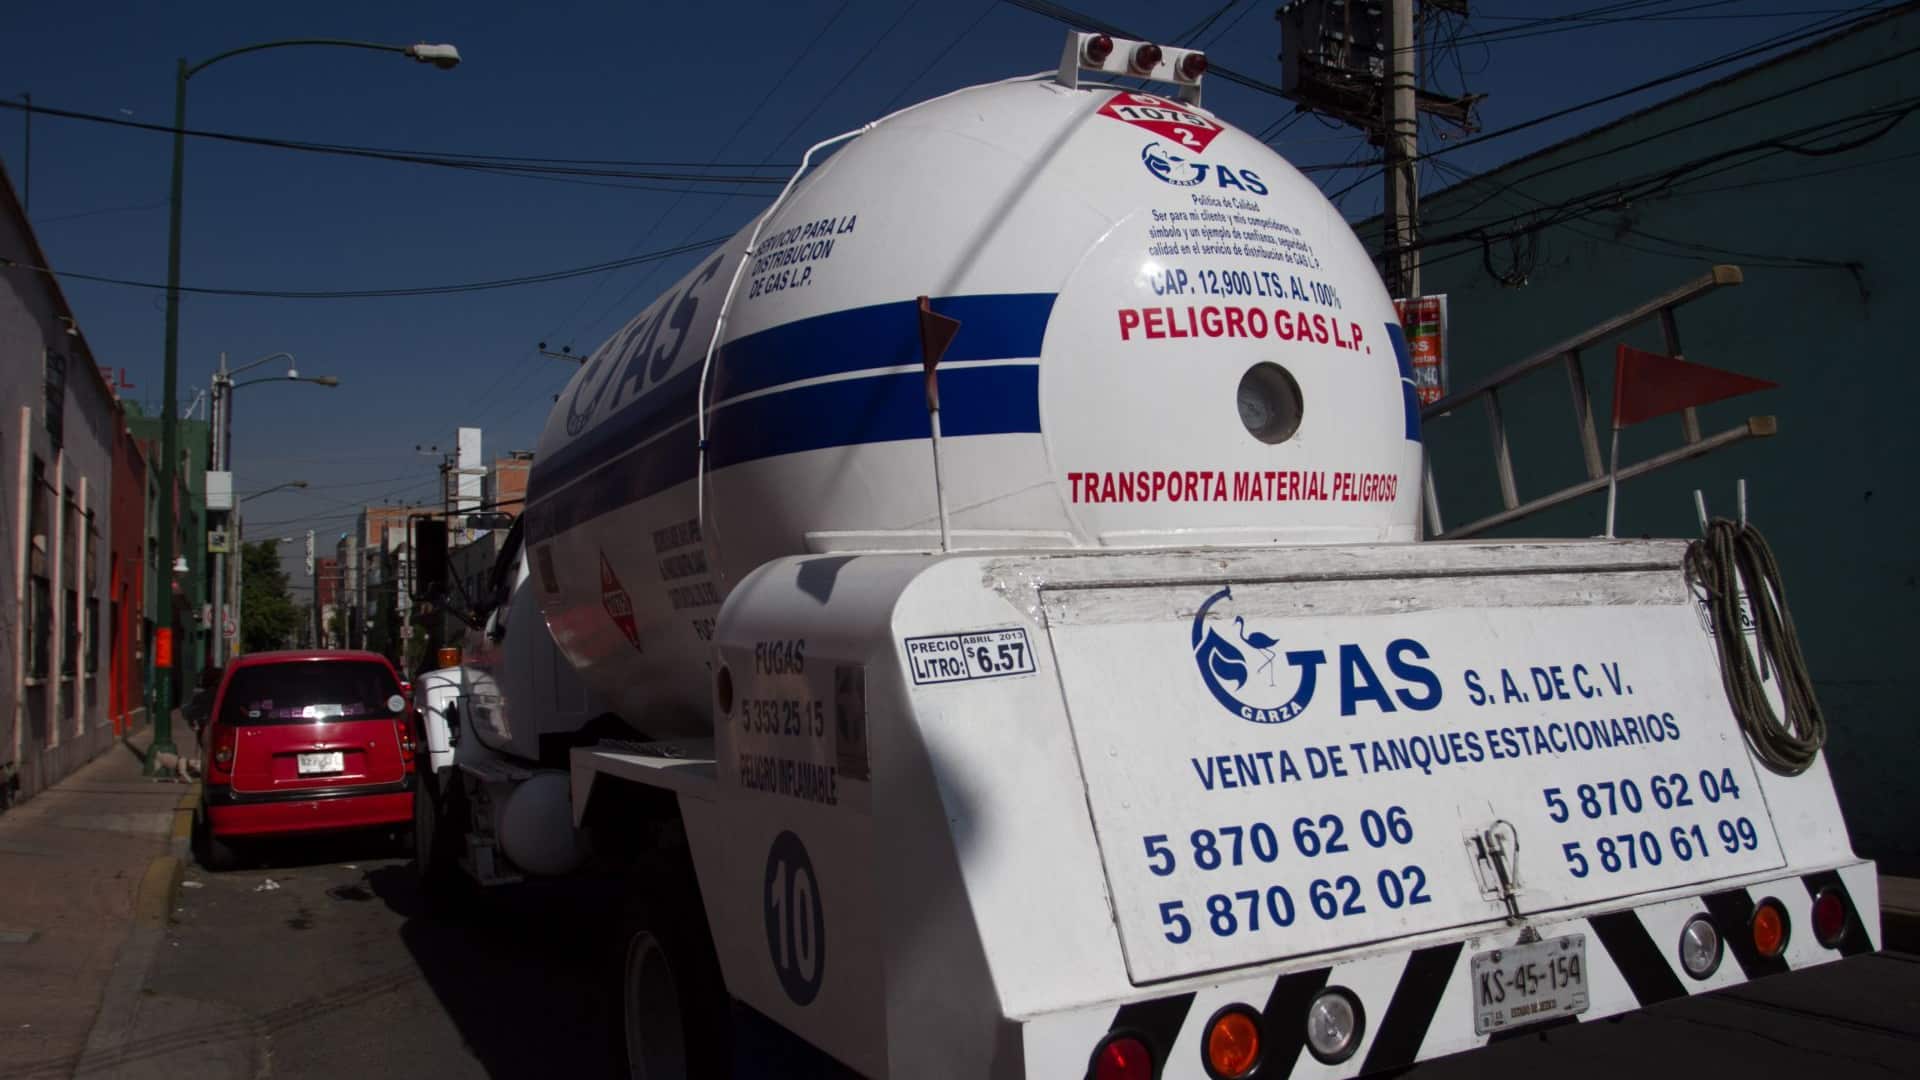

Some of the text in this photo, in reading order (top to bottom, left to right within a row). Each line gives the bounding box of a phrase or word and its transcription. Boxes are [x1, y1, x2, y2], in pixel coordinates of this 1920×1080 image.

[1119, 105, 1206, 127] 1075
[1172, 127, 1203, 146] 2
[1152, 209, 1167, 222] Ser
[1170, 212, 1188, 225] para
[1189, 210, 1199, 221] mi
[1200, 210, 1227, 222] cliente
[1233, 213, 1246, 225] mis
[1223, 197, 1232, 208] de
[801, 217, 837, 241] PARA
[837, 214, 857, 234] LA
[1189, 228, 1200, 237] un
[1201, 226, 1231, 241] ejemplo
[1232, 228, 1242, 239] de
[751, 238, 835, 277] DISTRIBUCION
[1149, 242, 1179, 256] calidad
[1181, 245, 1191, 255] en
[1192, 243, 1200, 255] el
[1201, 243, 1232, 256] servicio
[1233, 245, 1243, 256] de
[1293, 252, 1309, 268] GAS
[748, 277, 766, 300] DE
[764, 269, 790, 295] GAS
[1151, 268, 1342, 310] CAP. 12,900 LTS. AL 100%
[1118, 305, 1269, 342] PELIGRO
[1273, 309, 1330, 345] GAS
[1068, 470, 1398, 504] TRANSPORTA MATERIAL PELIGROSO
[755, 638, 806, 676] FUGAS
[911, 631, 1024, 654] PRECIO ABRIL 2013
[965, 641, 1027, 674] $6.57
[1530, 665, 1571, 702] DE
[741, 699, 825, 738] 5 353 25 15
[1240, 700, 1303, 724] GARZA
[1191, 711, 1681, 792] VENTA DE TANQUES ESTACIONARIOS
[739, 753, 778, 795] PELIGRO
[1543, 767, 1740, 824] 5 870 62 04
[1143, 805, 1414, 877] 5 870 62 06
[1562, 816, 1759, 879] 5 870 61 99
[771, 860, 817, 983] 10
[1158, 865, 1433, 945] 5 870 62 02
[1479, 954, 1582, 1007] KS-45-154
